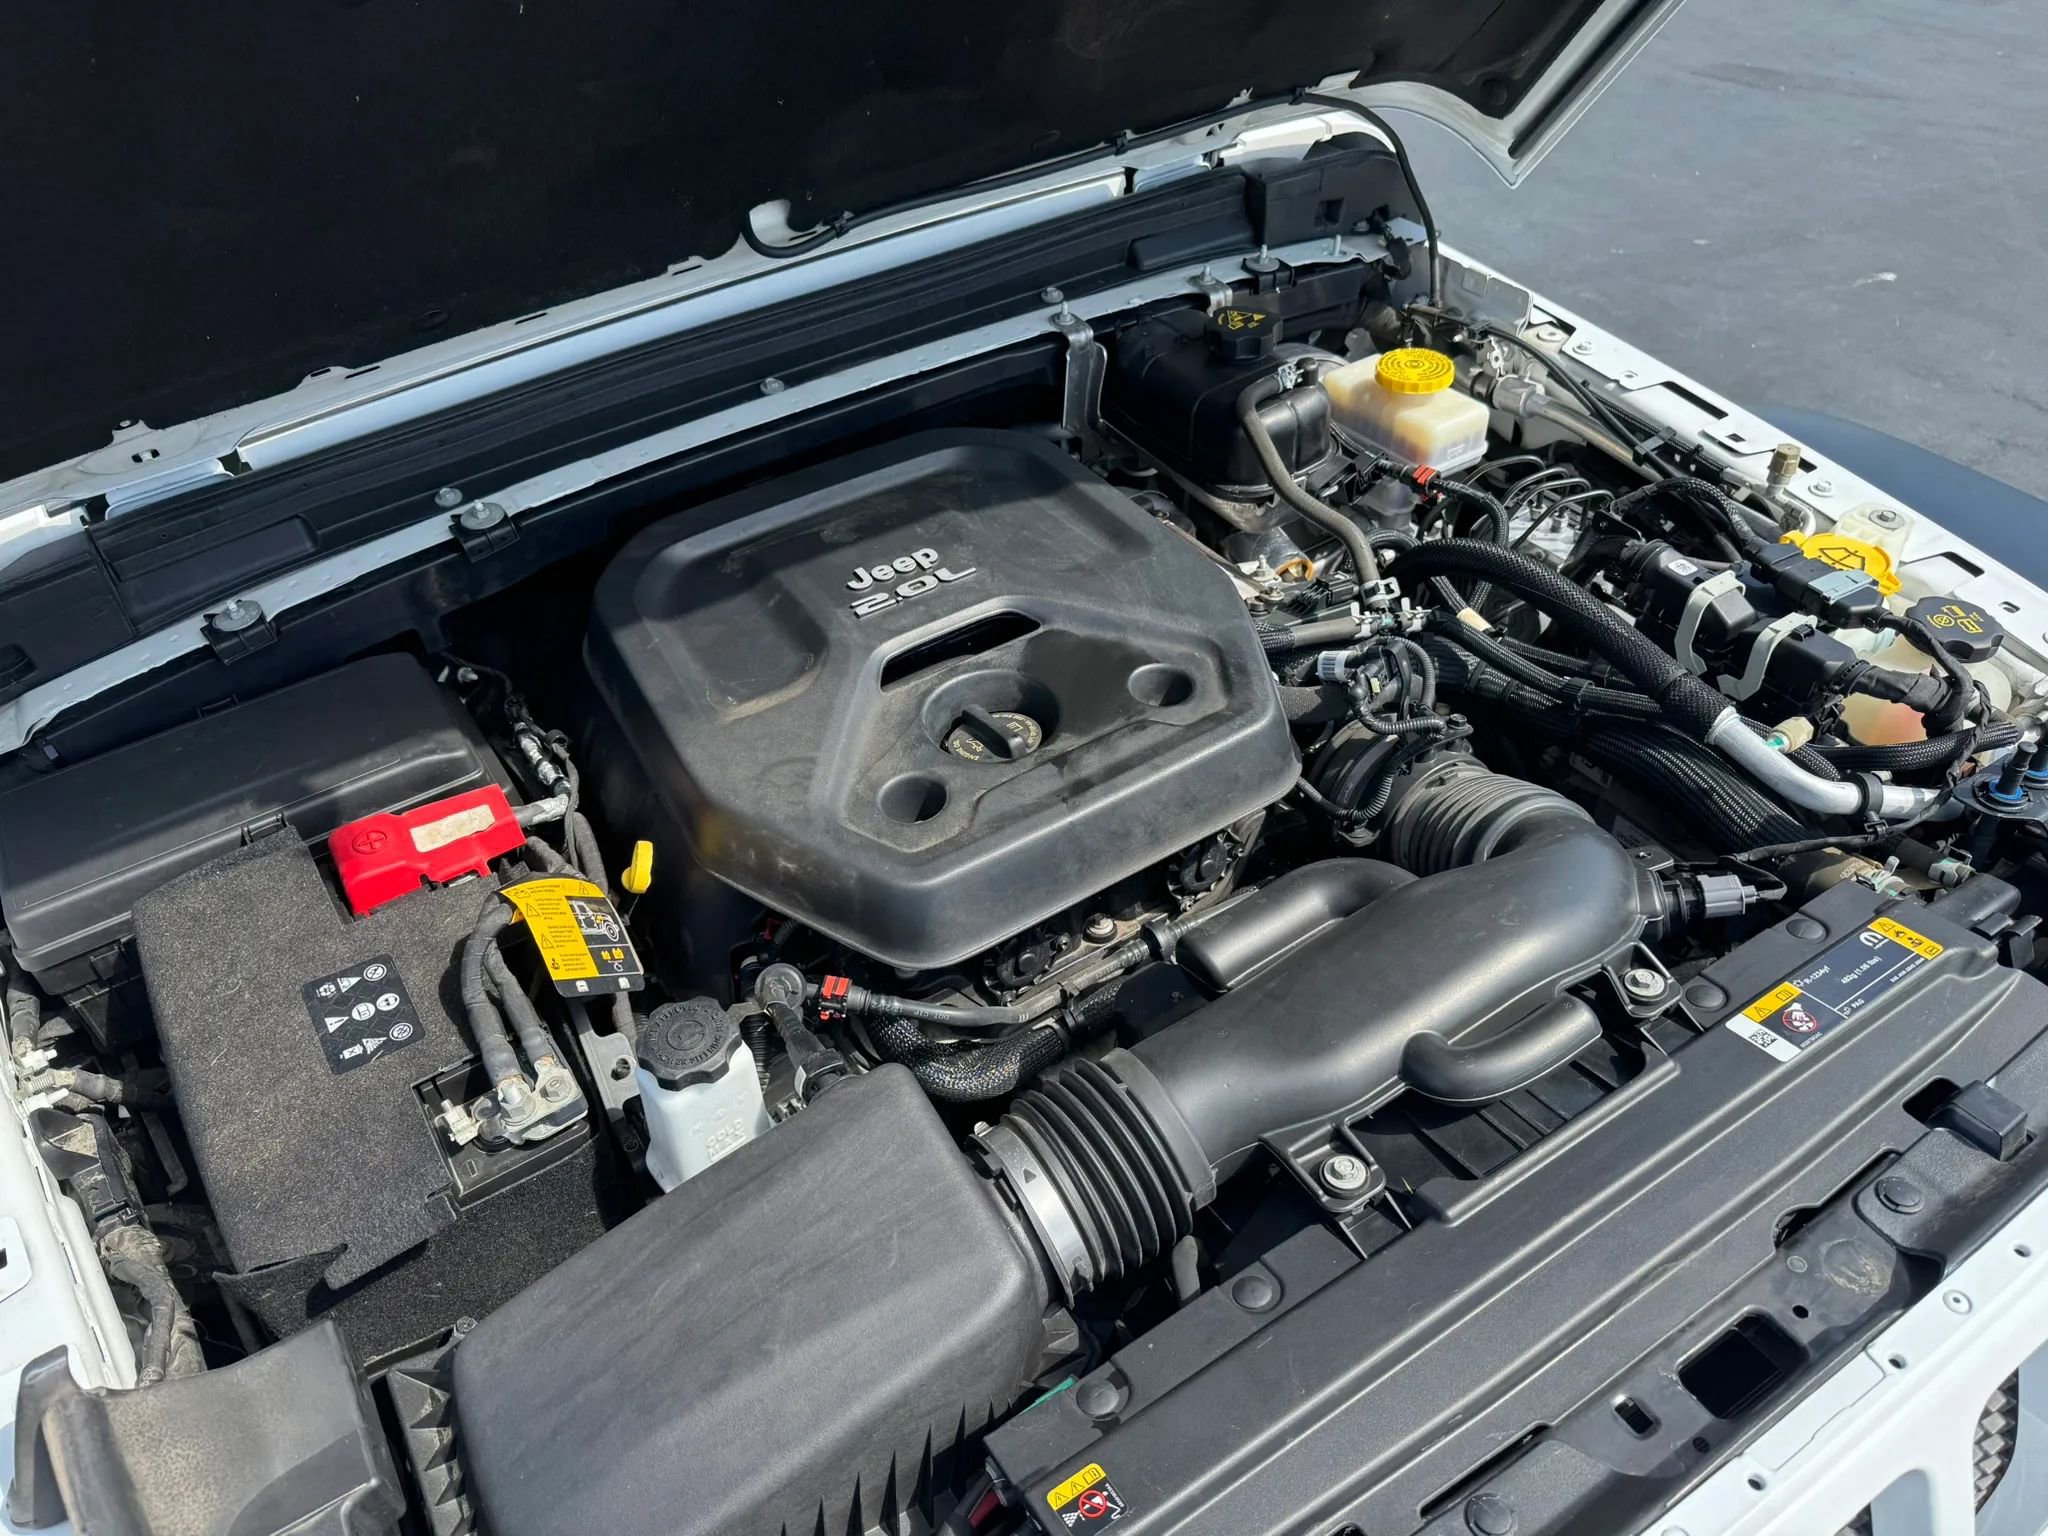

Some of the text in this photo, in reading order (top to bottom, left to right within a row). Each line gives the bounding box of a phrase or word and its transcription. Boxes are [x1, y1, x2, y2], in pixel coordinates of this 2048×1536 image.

[847, 548, 939, 590] Jeep
[850, 567, 977, 619] 2.0L
[956, 747, 979, 761] ENGINE
